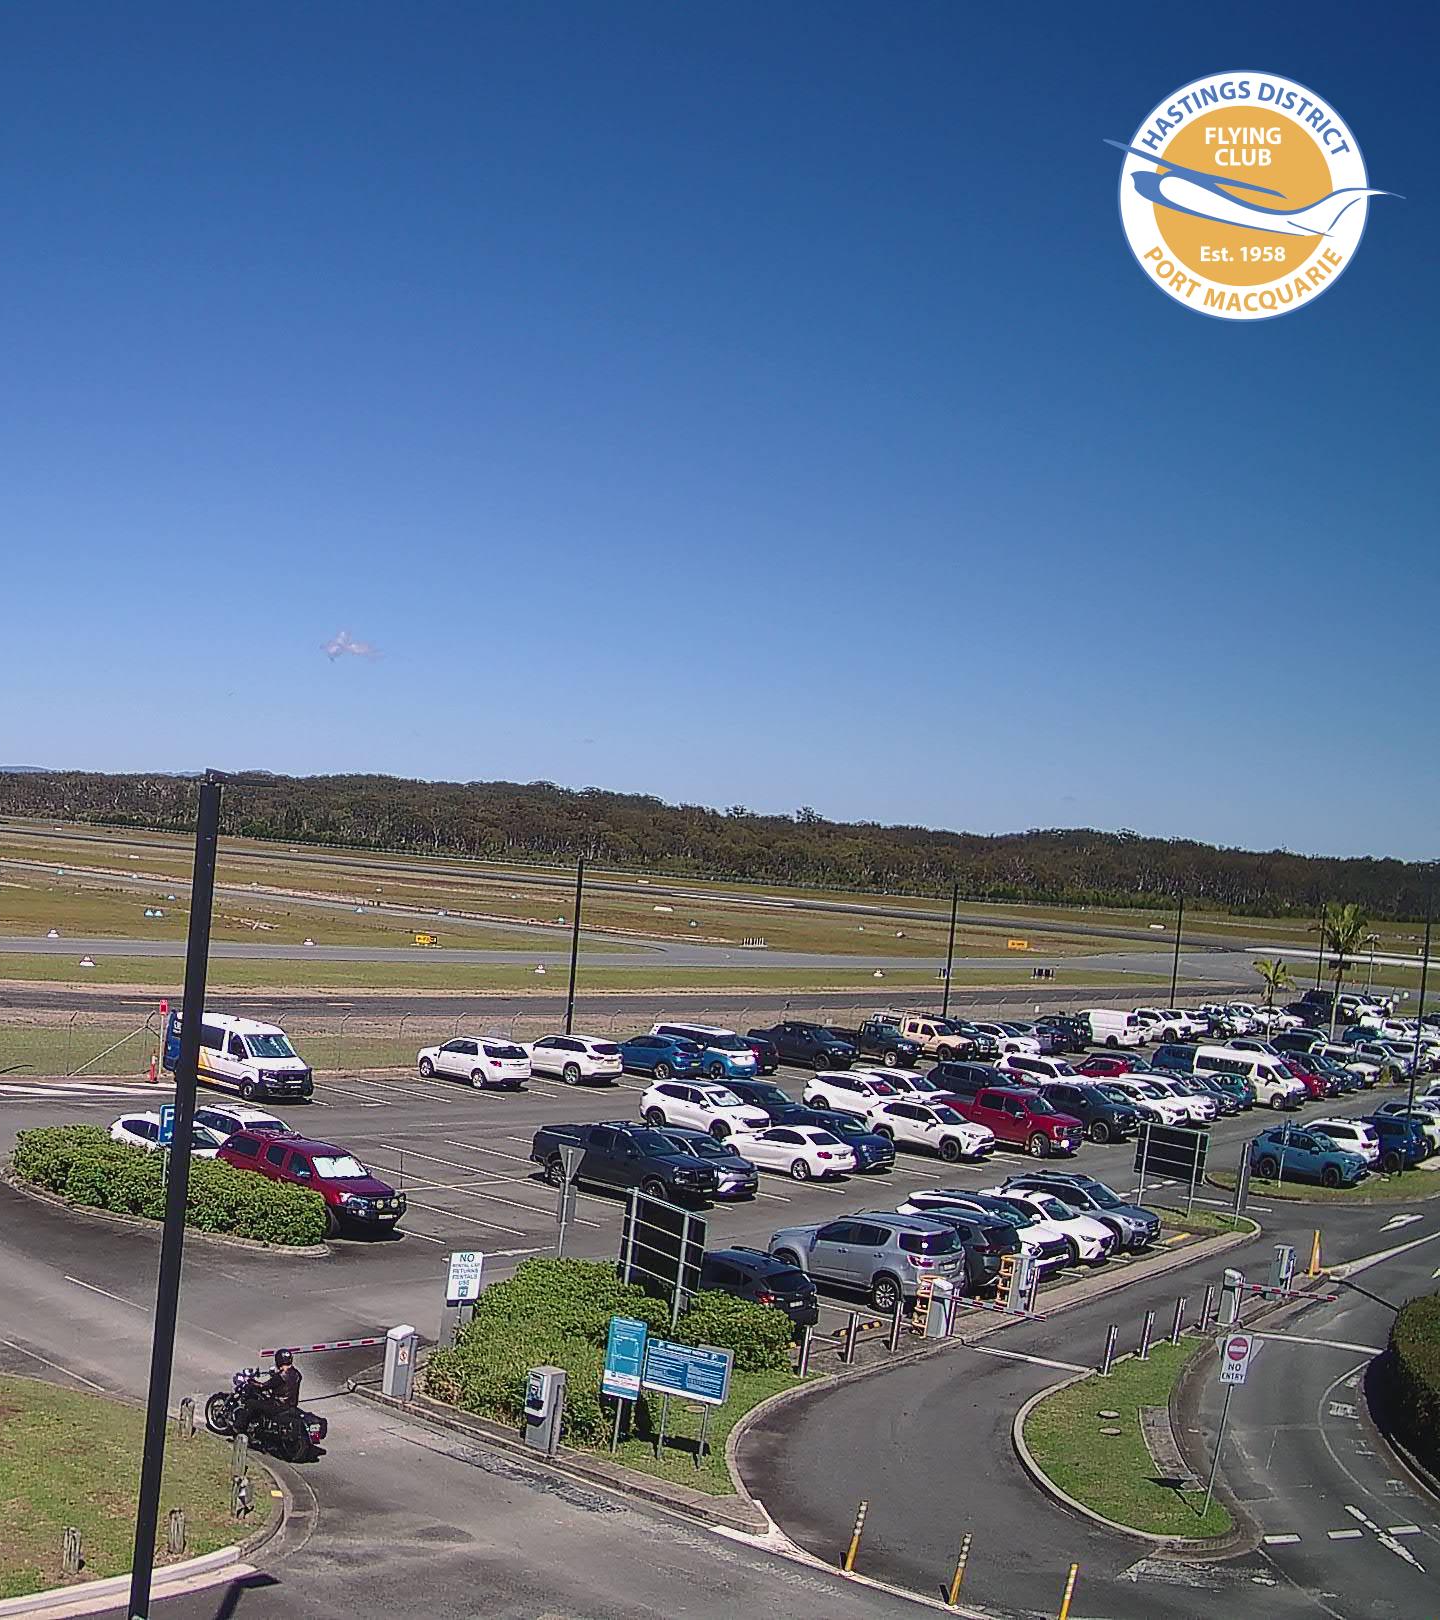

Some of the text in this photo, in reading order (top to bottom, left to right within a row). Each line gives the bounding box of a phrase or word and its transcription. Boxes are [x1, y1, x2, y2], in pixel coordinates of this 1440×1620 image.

[163, 1109, 175, 1128] P
[460, 1253, 475, 1263] NO
[1227, 1363, 1242, 1371] NO
[1221, 1372, 1244, 1380] ENTRY
